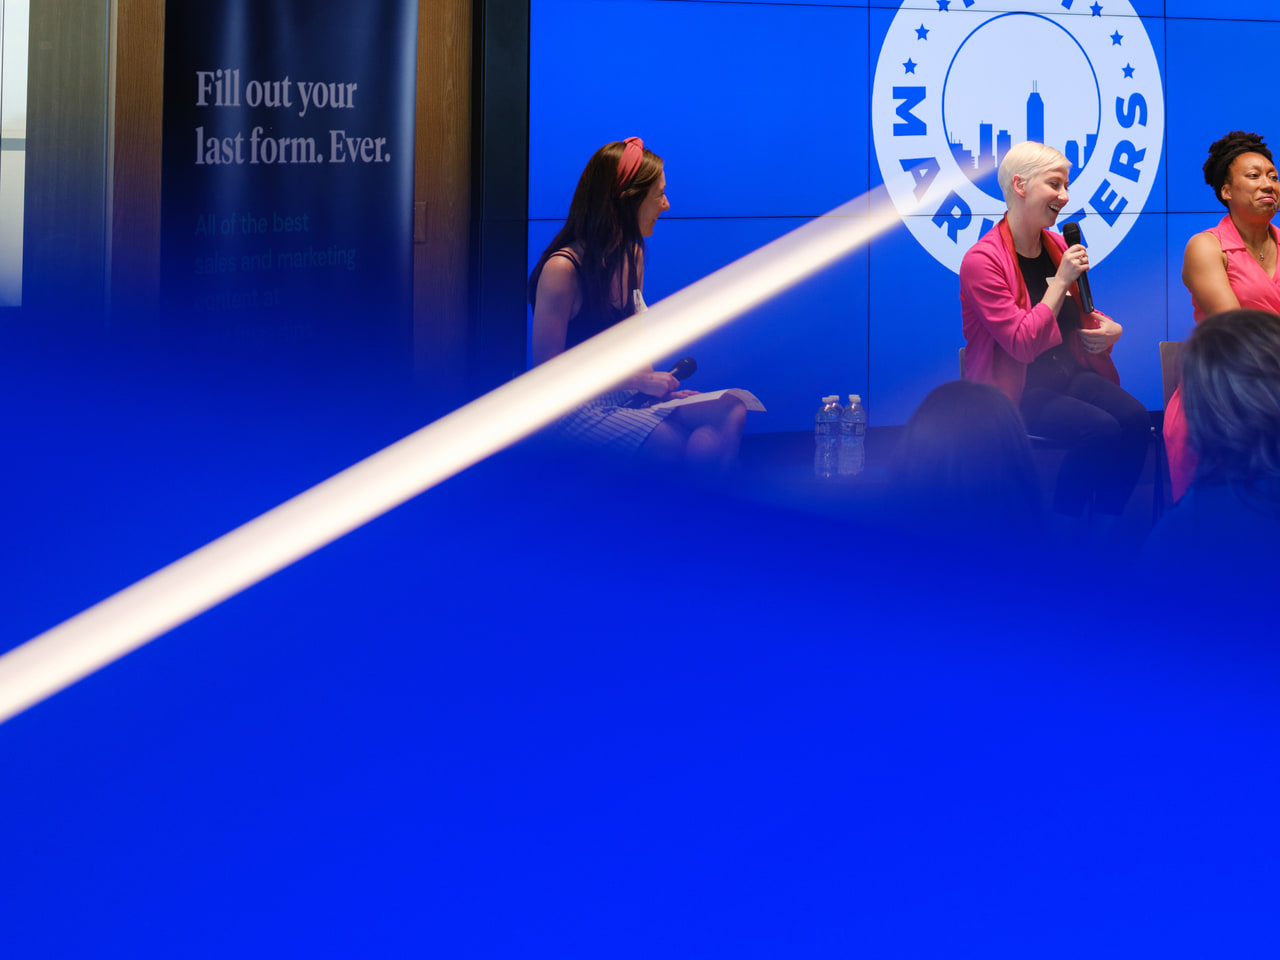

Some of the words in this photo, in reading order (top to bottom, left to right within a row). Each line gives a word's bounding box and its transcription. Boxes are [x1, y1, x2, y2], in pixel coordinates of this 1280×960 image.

[195, 68, 240, 108] Fill
[245, 75, 292, 108] out
[297, 79, 357, 117] your
[195, 126, 244, 165] last
[249, 126, 323, 165] form.
[329, 129, 391, 164] Ever.
[892, 86, 1148, 250] MARETERS
[194, 213, 216, 236] All
[220, 212, 237, 236] of
[241, 212, 268, 233] the
[273, 211, 310, 233] best
[193, 250, 236, 275] sales
[240, 248, 272, 271] and
[277, 244, 357, 271] marketing
